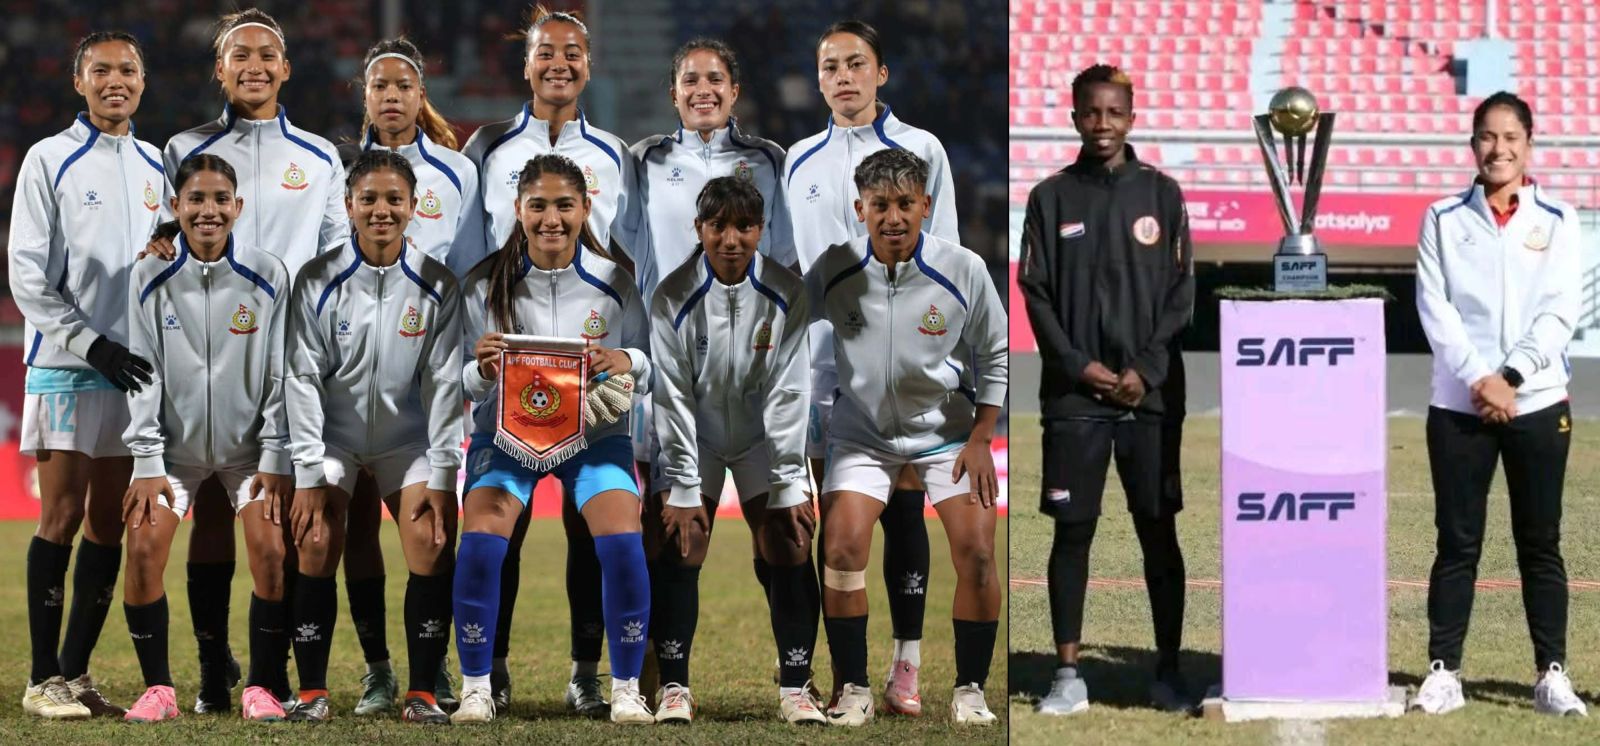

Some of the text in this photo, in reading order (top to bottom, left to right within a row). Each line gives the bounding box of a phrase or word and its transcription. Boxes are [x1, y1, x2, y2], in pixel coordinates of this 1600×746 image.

[1313, 211, 1390, 234] atsalya
[1281, 261, 1317, 271] SAFF
[1236, 337, 1355, 366] SAFF
[507, 356, 577, 370] APF FOOTBALL CLUB
[44, 393, 77, 433] 12
[1236, 492, 1356, 521] SAFF
[295, 634, 322, 643] KELME
[785, 659, 809, 667] KELME
